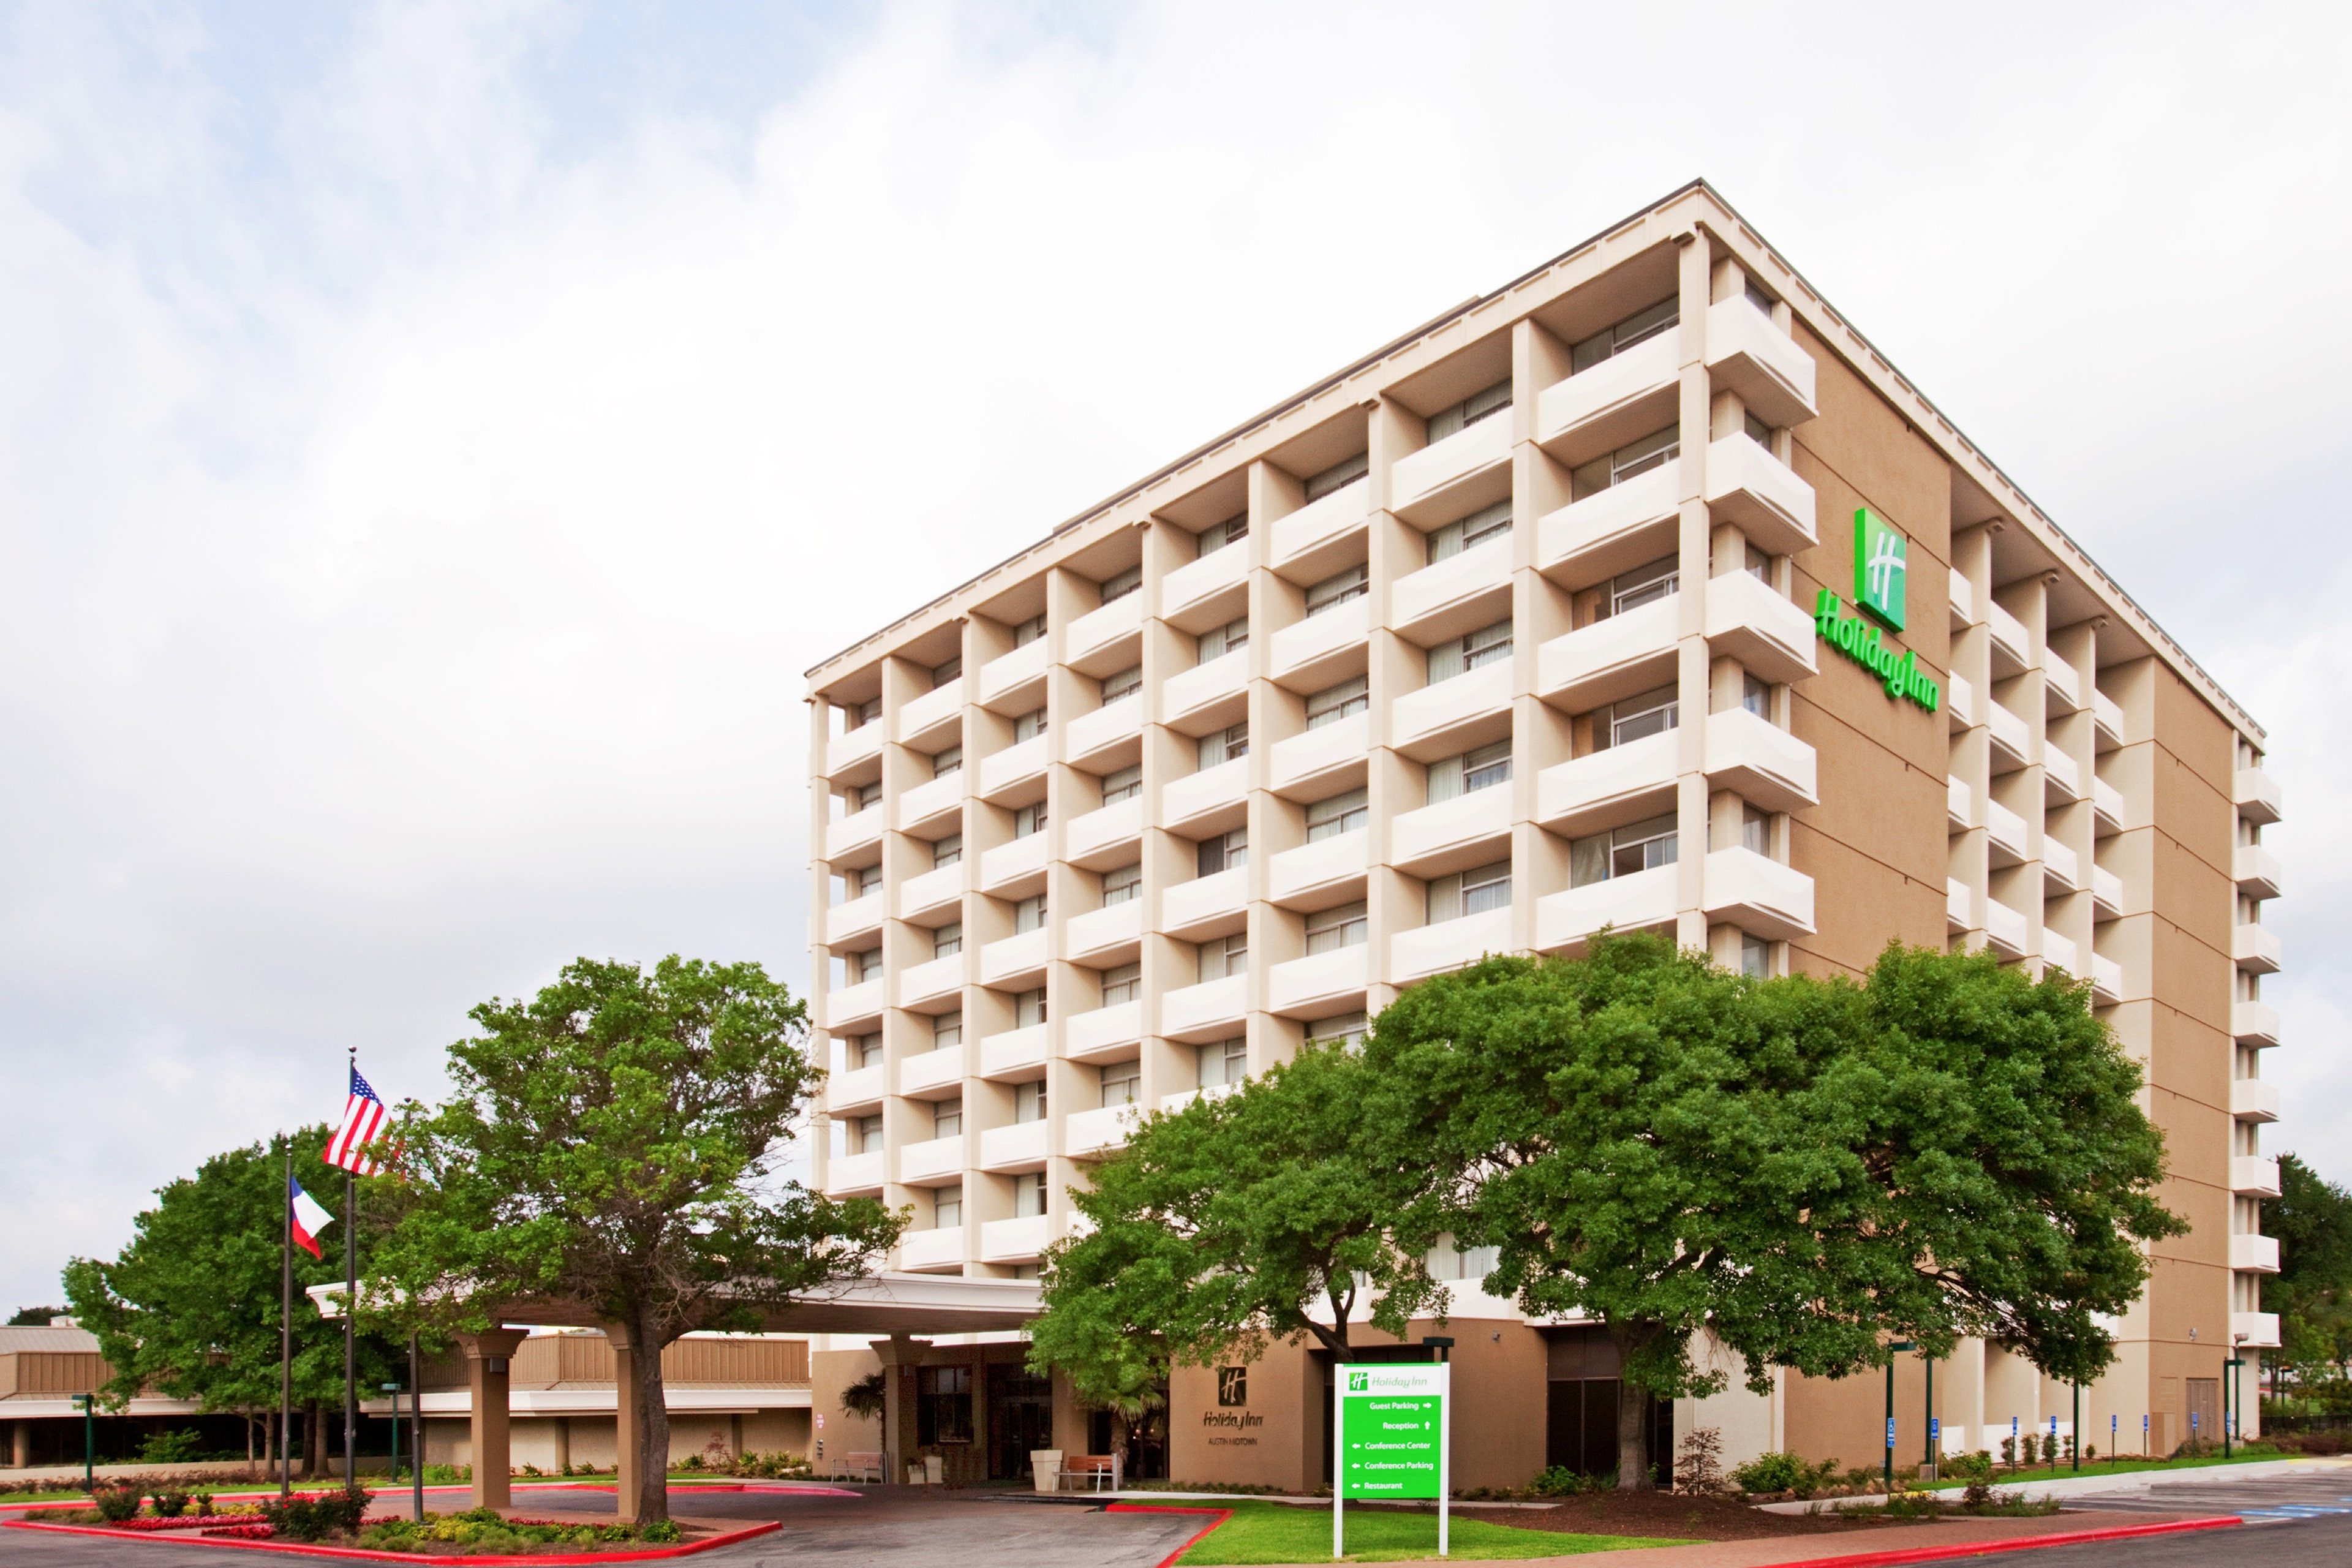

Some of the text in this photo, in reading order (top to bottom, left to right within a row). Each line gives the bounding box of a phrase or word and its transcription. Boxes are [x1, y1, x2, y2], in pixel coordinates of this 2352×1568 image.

[1814, 587, 1939, 712] Holiday Inn
[1372, 1376, 1410, 1389] Holiday
[1412, 1376, 1428, 1386] Inn
[1392, 1402, 1419, 1411] Parking
[1204, 1411, 1264, 1430] Holiday Inn
[1382, 1422, 1420, 1431] Reception
[1406, 1461, 1434, 1471] Parking
